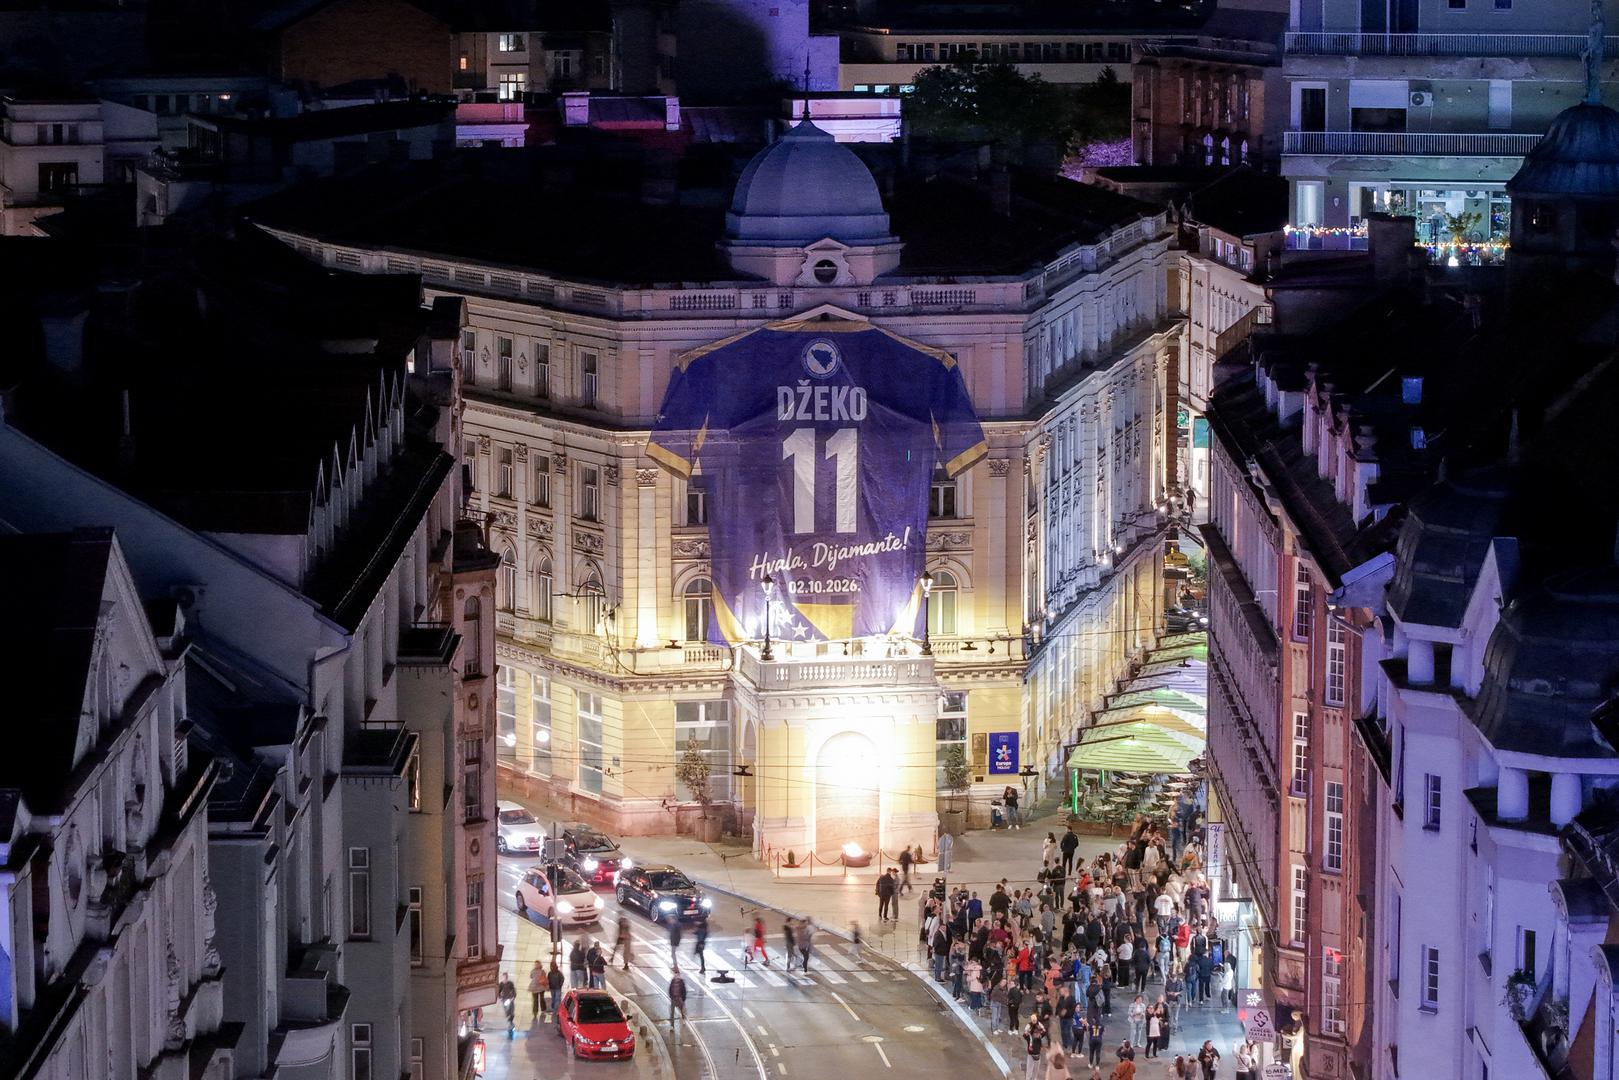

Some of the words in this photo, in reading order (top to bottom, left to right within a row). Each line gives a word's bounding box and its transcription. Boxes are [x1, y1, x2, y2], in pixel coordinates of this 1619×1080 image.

[777, 379, 868, 421] DŽEKO
[782, 428, 857, 534] 11
[750, 547, 808, 580] Hvala,
[811, 526, 911, 571] Dijamante!
[788, 579, 862, 594] 02.10.2026.
